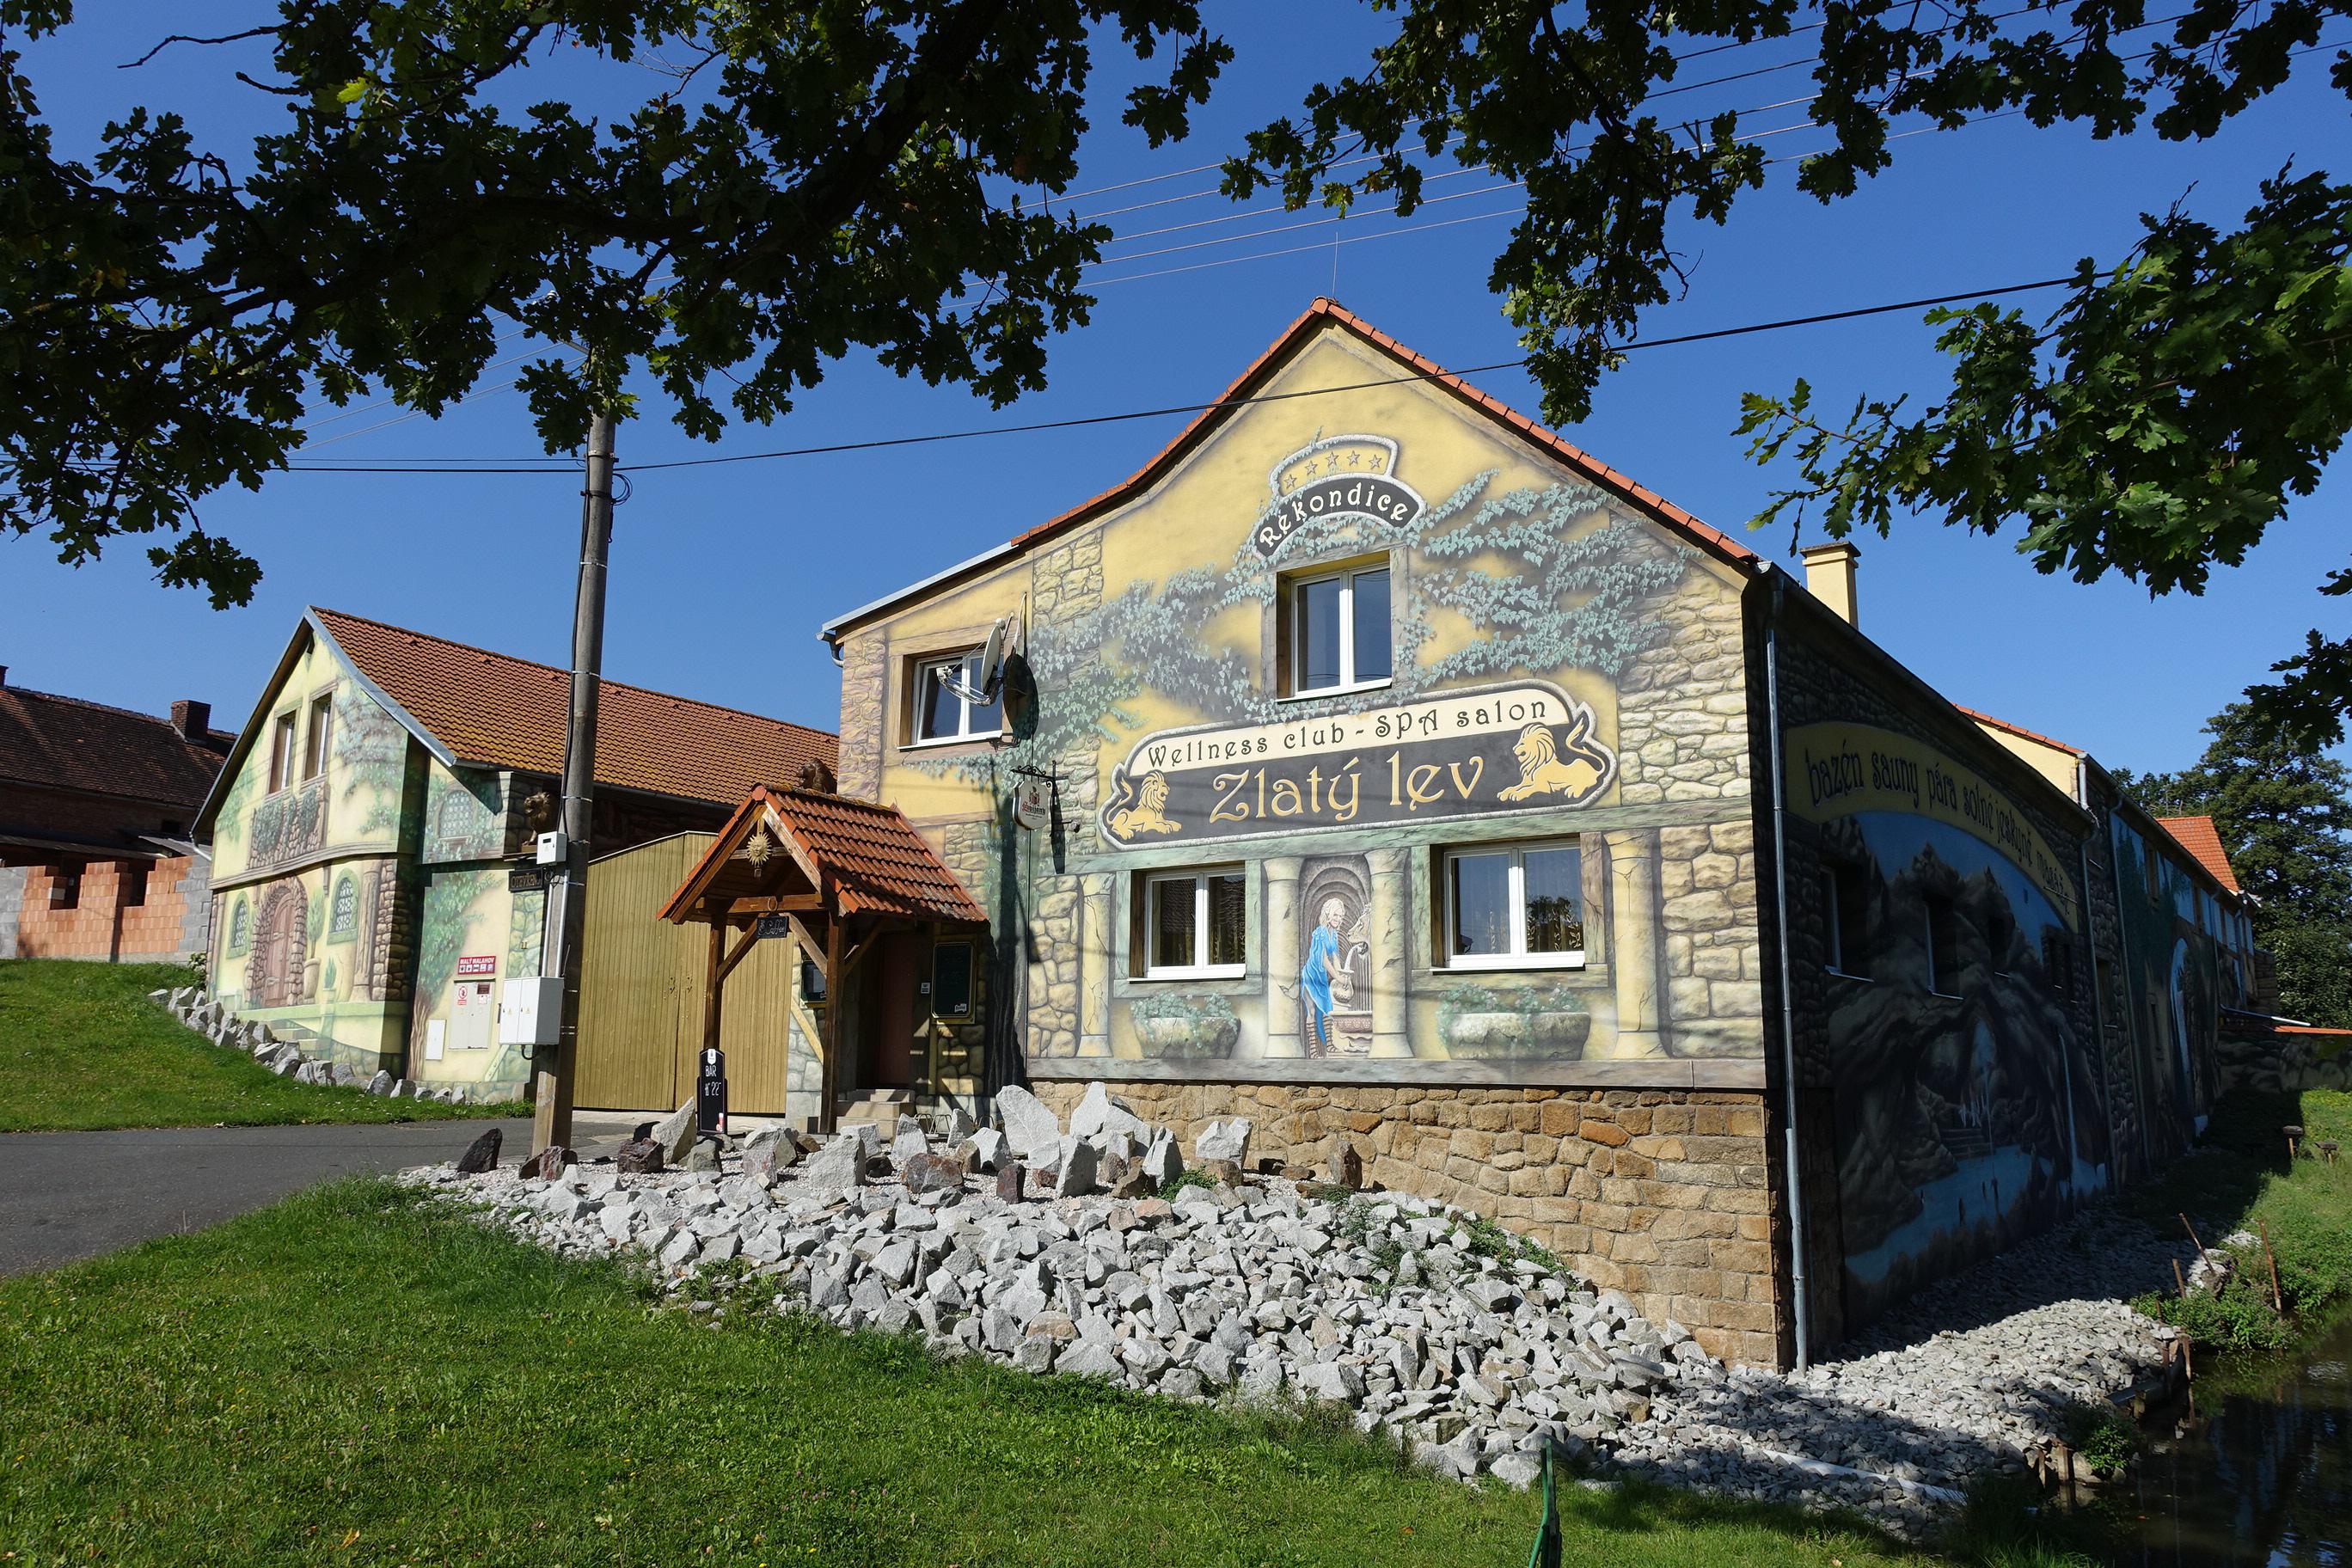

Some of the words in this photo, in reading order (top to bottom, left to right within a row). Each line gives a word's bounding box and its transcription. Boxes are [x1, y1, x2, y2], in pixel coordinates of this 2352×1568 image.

[1259, 482, 1409, 548] Rekondice
[1148, 737, 1268, 767] Wellness
[1283, 723, 1344, 749] club
[1375, 709, 1438, 739] SPA
[1456, 700, 1546, 727] salon
[1210, 756, 1363, 824] Zlatý
[1386, 750, 1485, 812] lev
[1804, 738, 1865, 807] bazén
[1871, 750, 1920, 810] sauny
[1926, 761, 1958, 812] pára
[1963, 782, 1995, 834] solné
[705, 1065, 717, 1077] BAR
